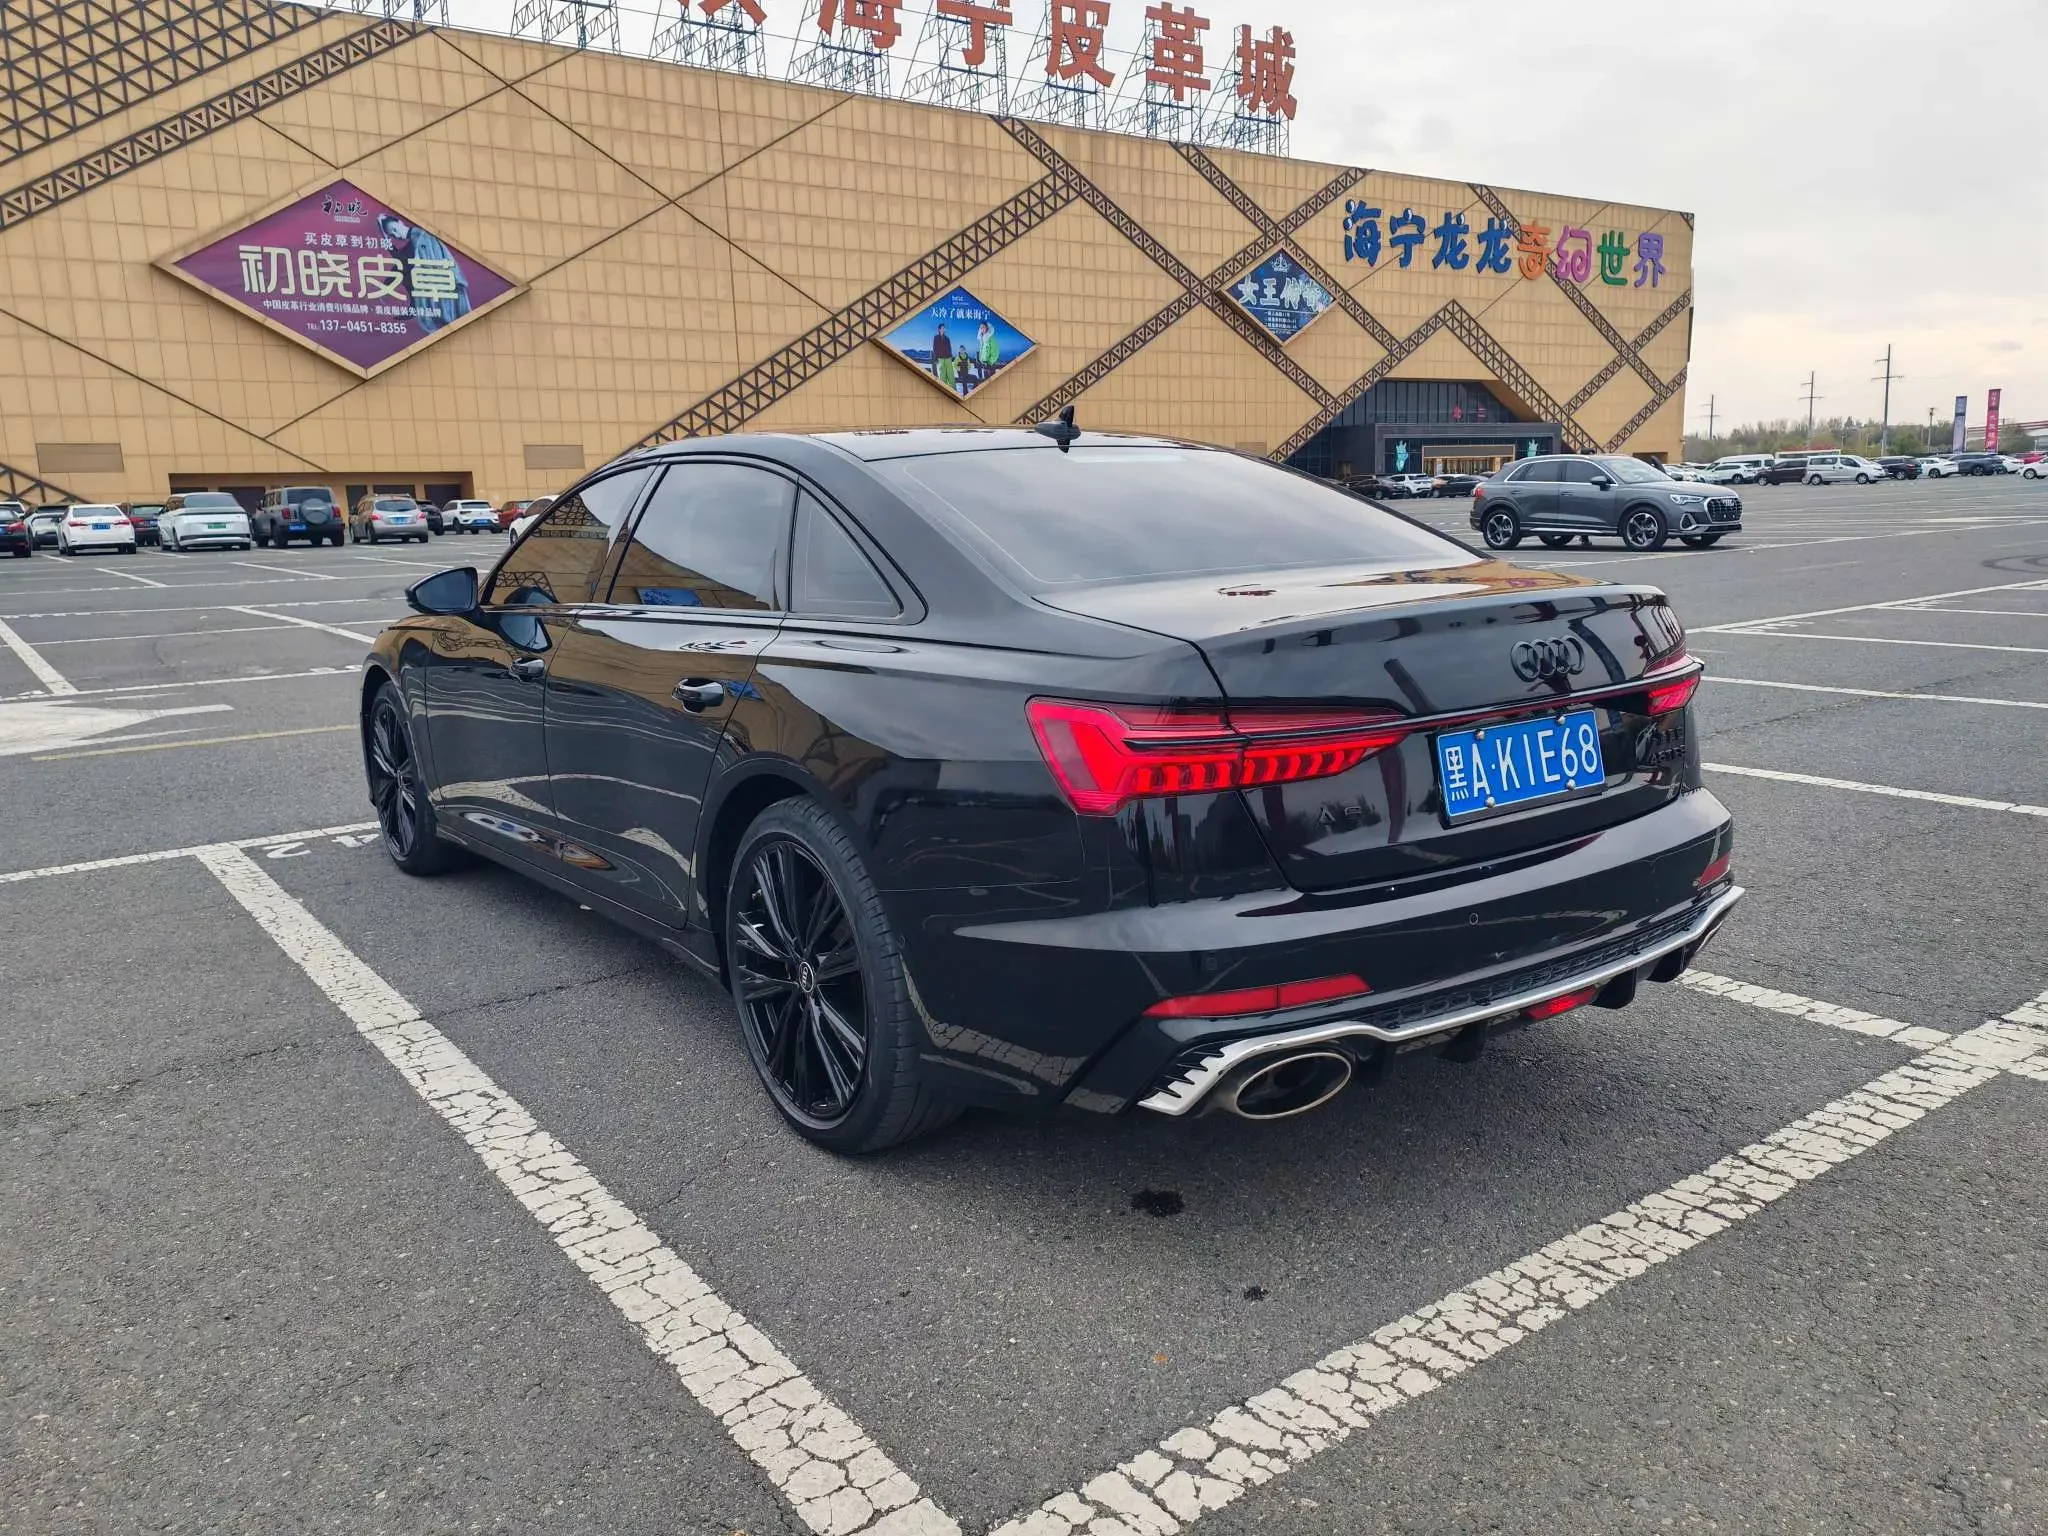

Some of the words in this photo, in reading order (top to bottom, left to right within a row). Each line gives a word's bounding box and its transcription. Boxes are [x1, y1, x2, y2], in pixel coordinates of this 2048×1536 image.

[678, 0, 1297, 120] 宁皮革城
[304, 231, 394, 251] 买皮草到初晓
[1342, 198, 1667, 289] 海宁龙龙奇幻世界
[238, 244, 459, 302] 初晓皮草
[1237, 272, 1322, 312] 女王传奇
[319, 319, 407, 334] 137-0451-8355
